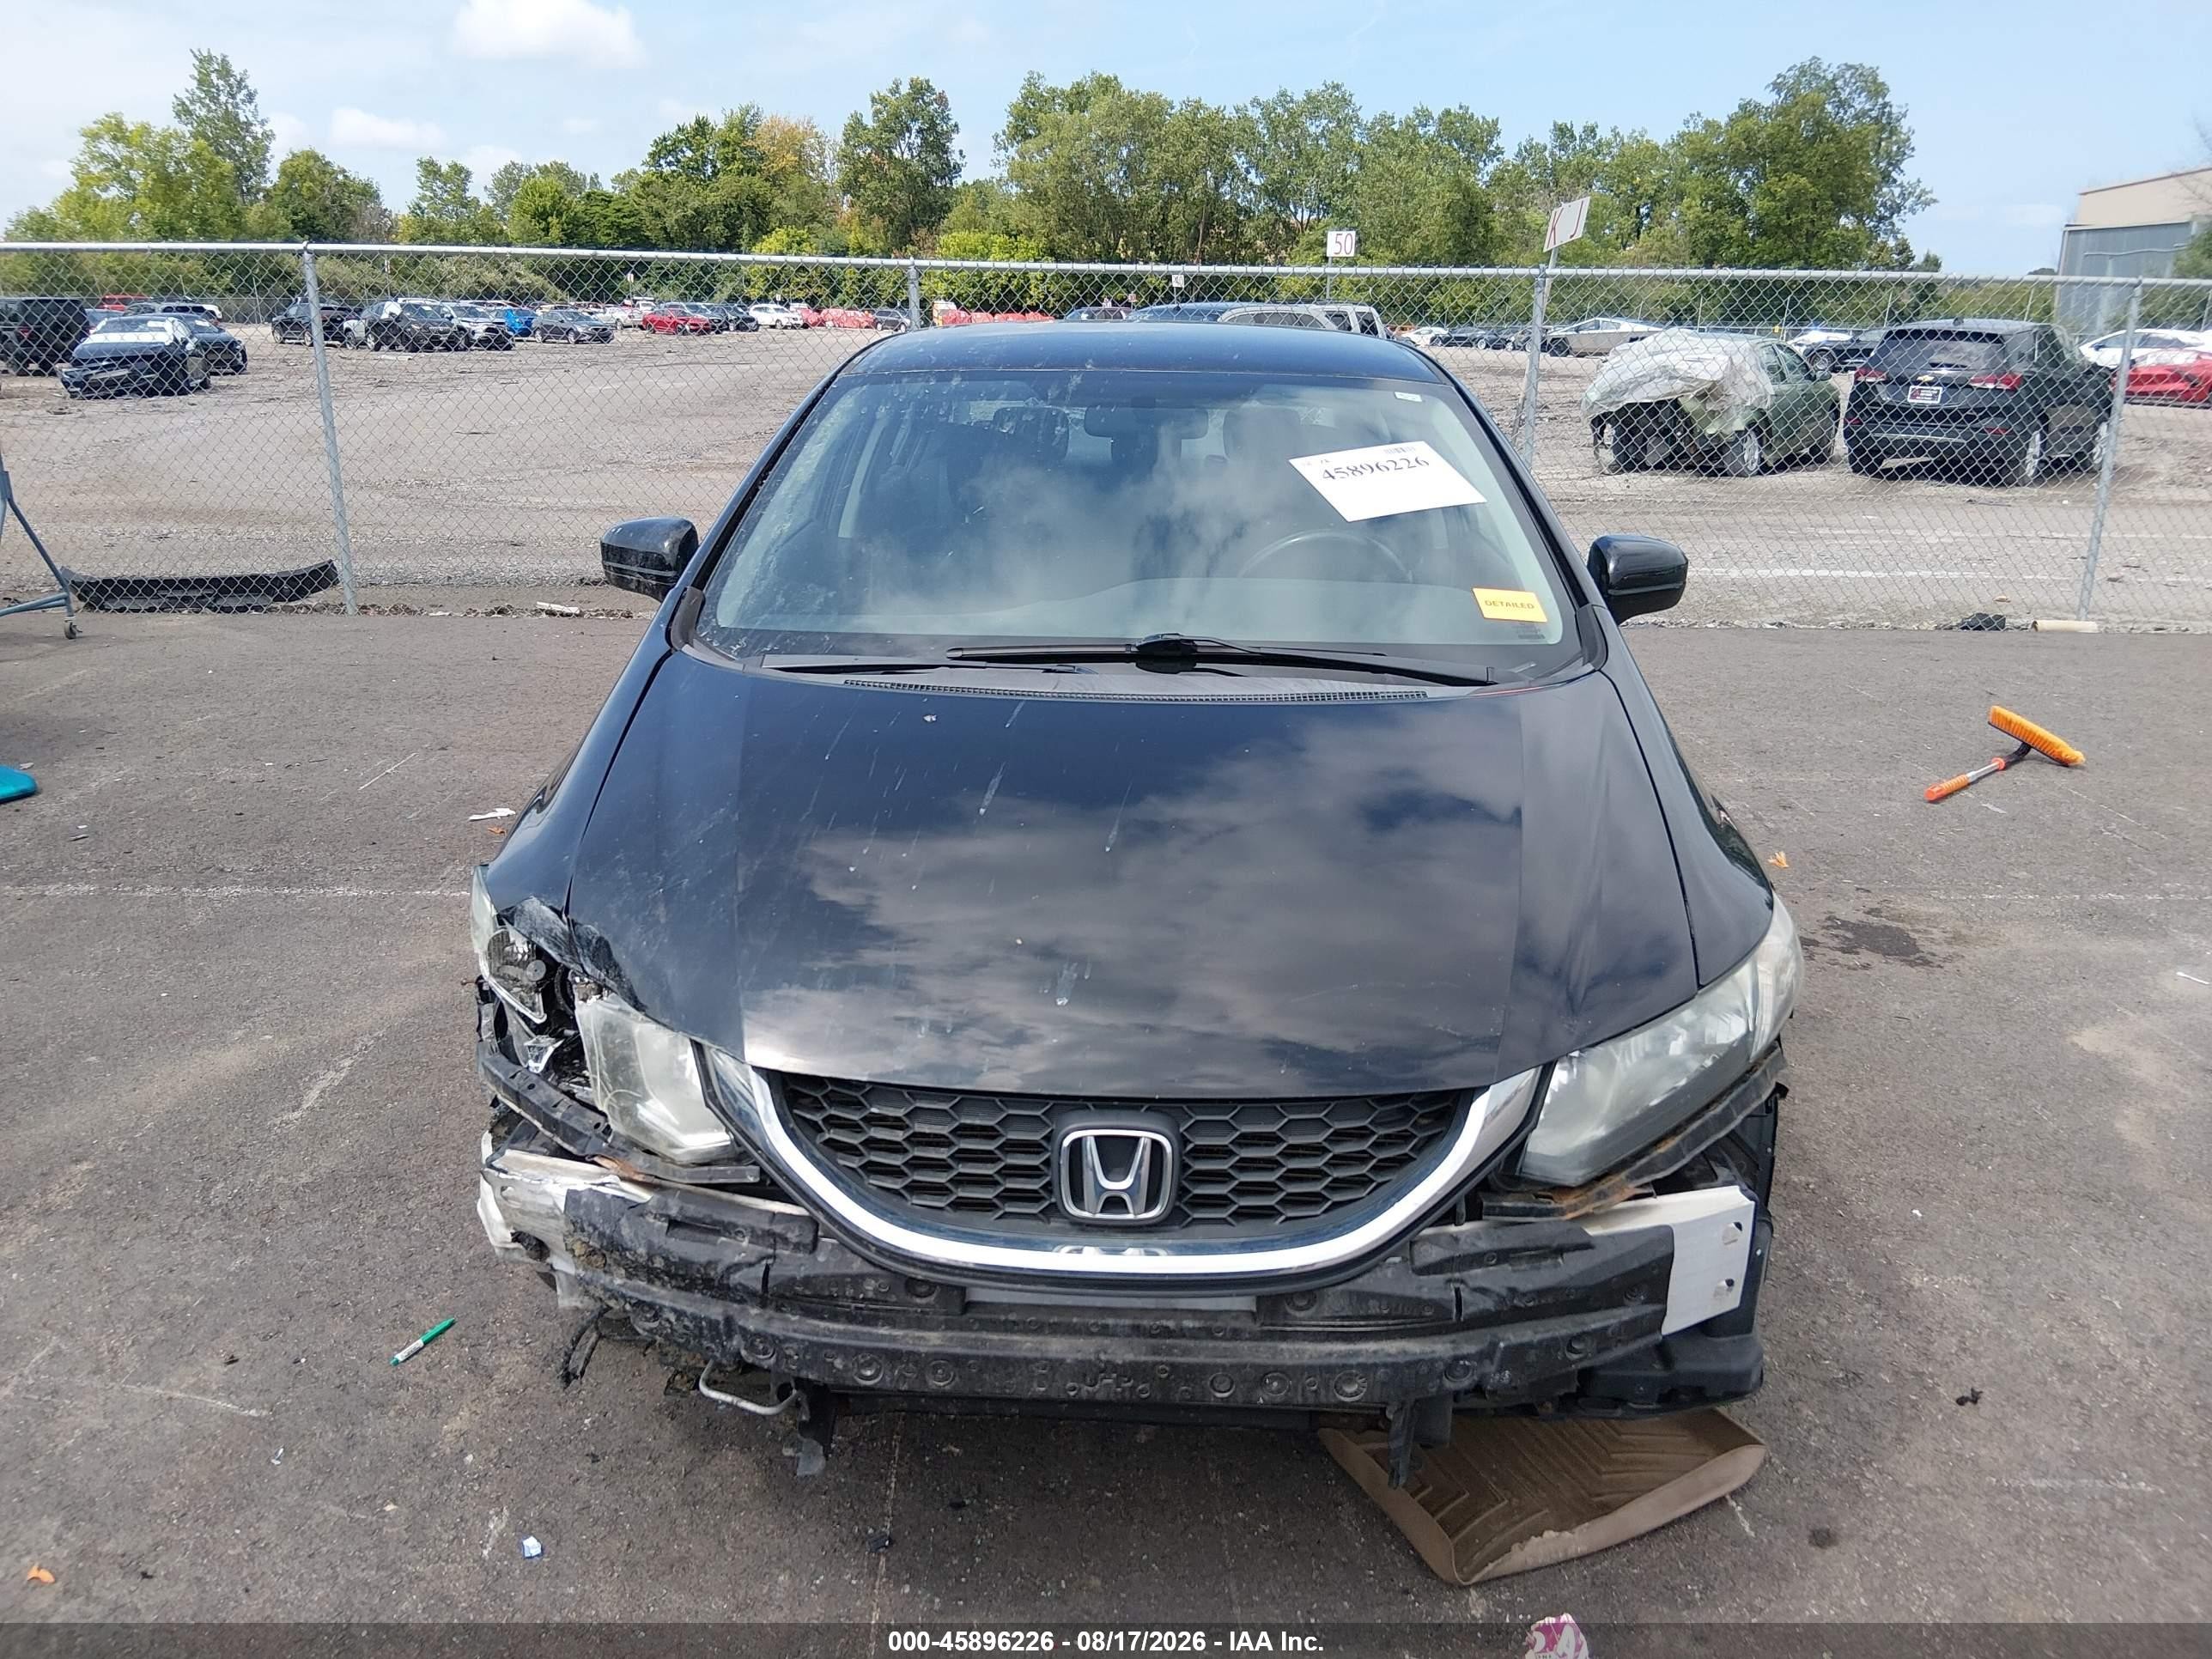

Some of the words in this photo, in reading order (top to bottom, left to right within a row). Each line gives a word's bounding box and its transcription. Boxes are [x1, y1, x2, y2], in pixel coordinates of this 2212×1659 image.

[1547, 207, 1565, 250] K
[1569, 199, 1584, 240] J
[1334, 233, 1353, 255] 50
[1322, 456, 1430, 481] 45896226
[1484, 600, 1534, 610] DETAILED
